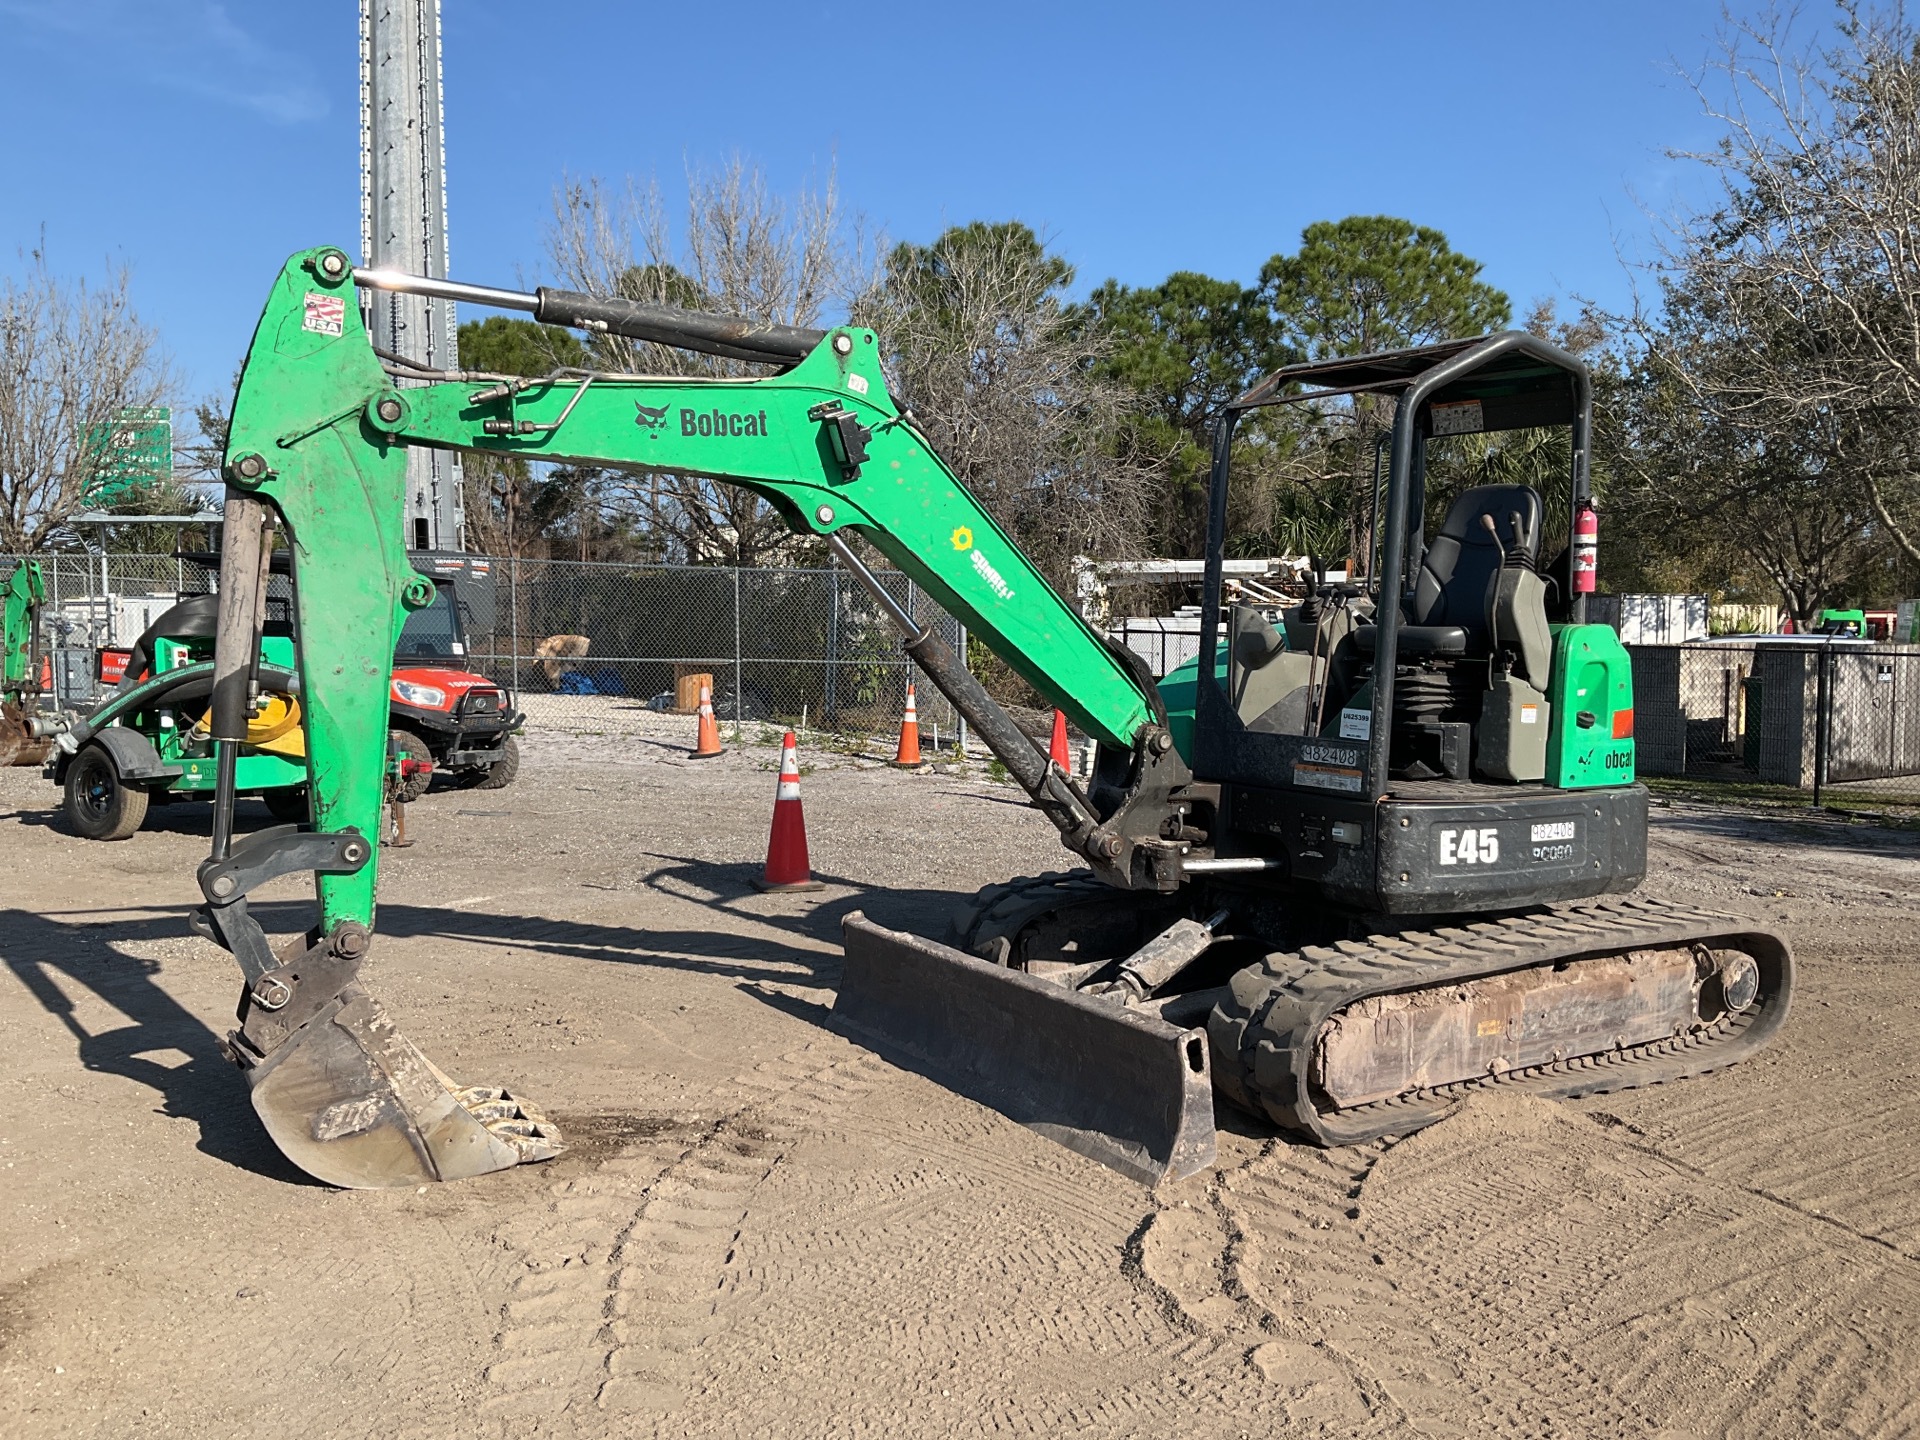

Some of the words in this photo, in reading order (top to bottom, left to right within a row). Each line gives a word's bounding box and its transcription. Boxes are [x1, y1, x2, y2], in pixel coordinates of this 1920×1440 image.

[304, 318, 340, 333] USA
[680, 408, 768, 437] Bobcat
[1343, 713, 1370, 722] U625399
[1305, 746, 1356, 765] 982408
[1532, 823, 1574, 840] 982408
[1440, 829, 1499, 865] E45
